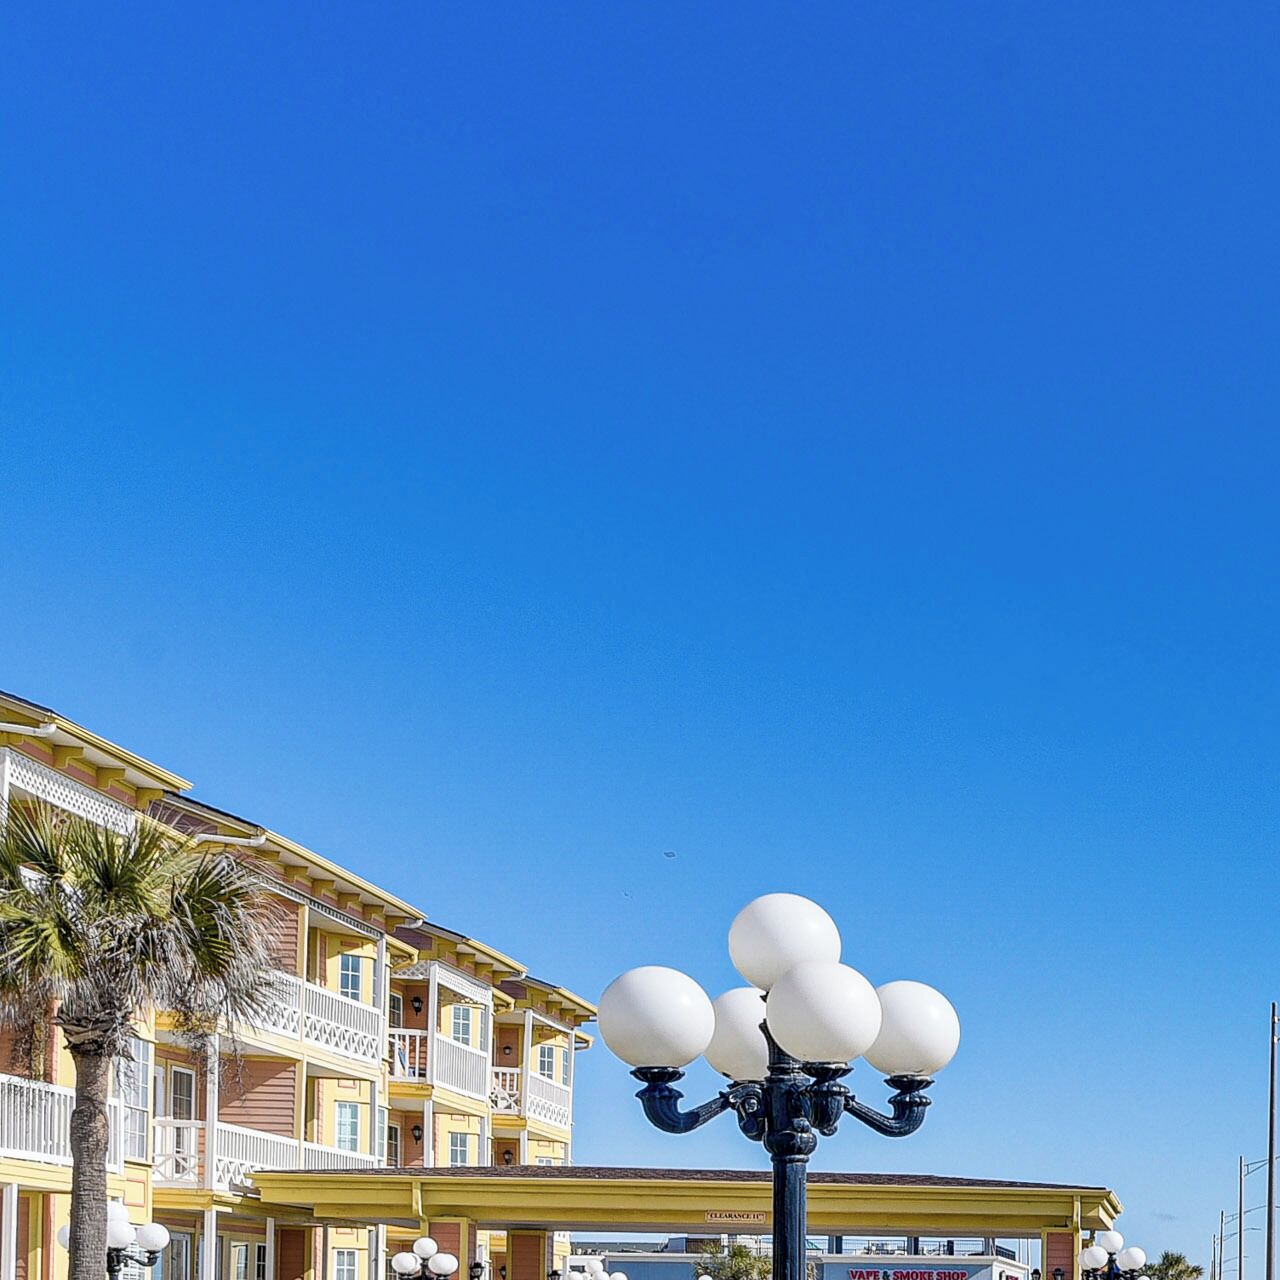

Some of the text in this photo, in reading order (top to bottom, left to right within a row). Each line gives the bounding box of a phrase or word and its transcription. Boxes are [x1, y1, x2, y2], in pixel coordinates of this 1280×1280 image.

[849, 1270, 880, 1280] VAPE
[882, 1270, 890, 1280] &
[892, 1270, 934, 1280] SMOKE
